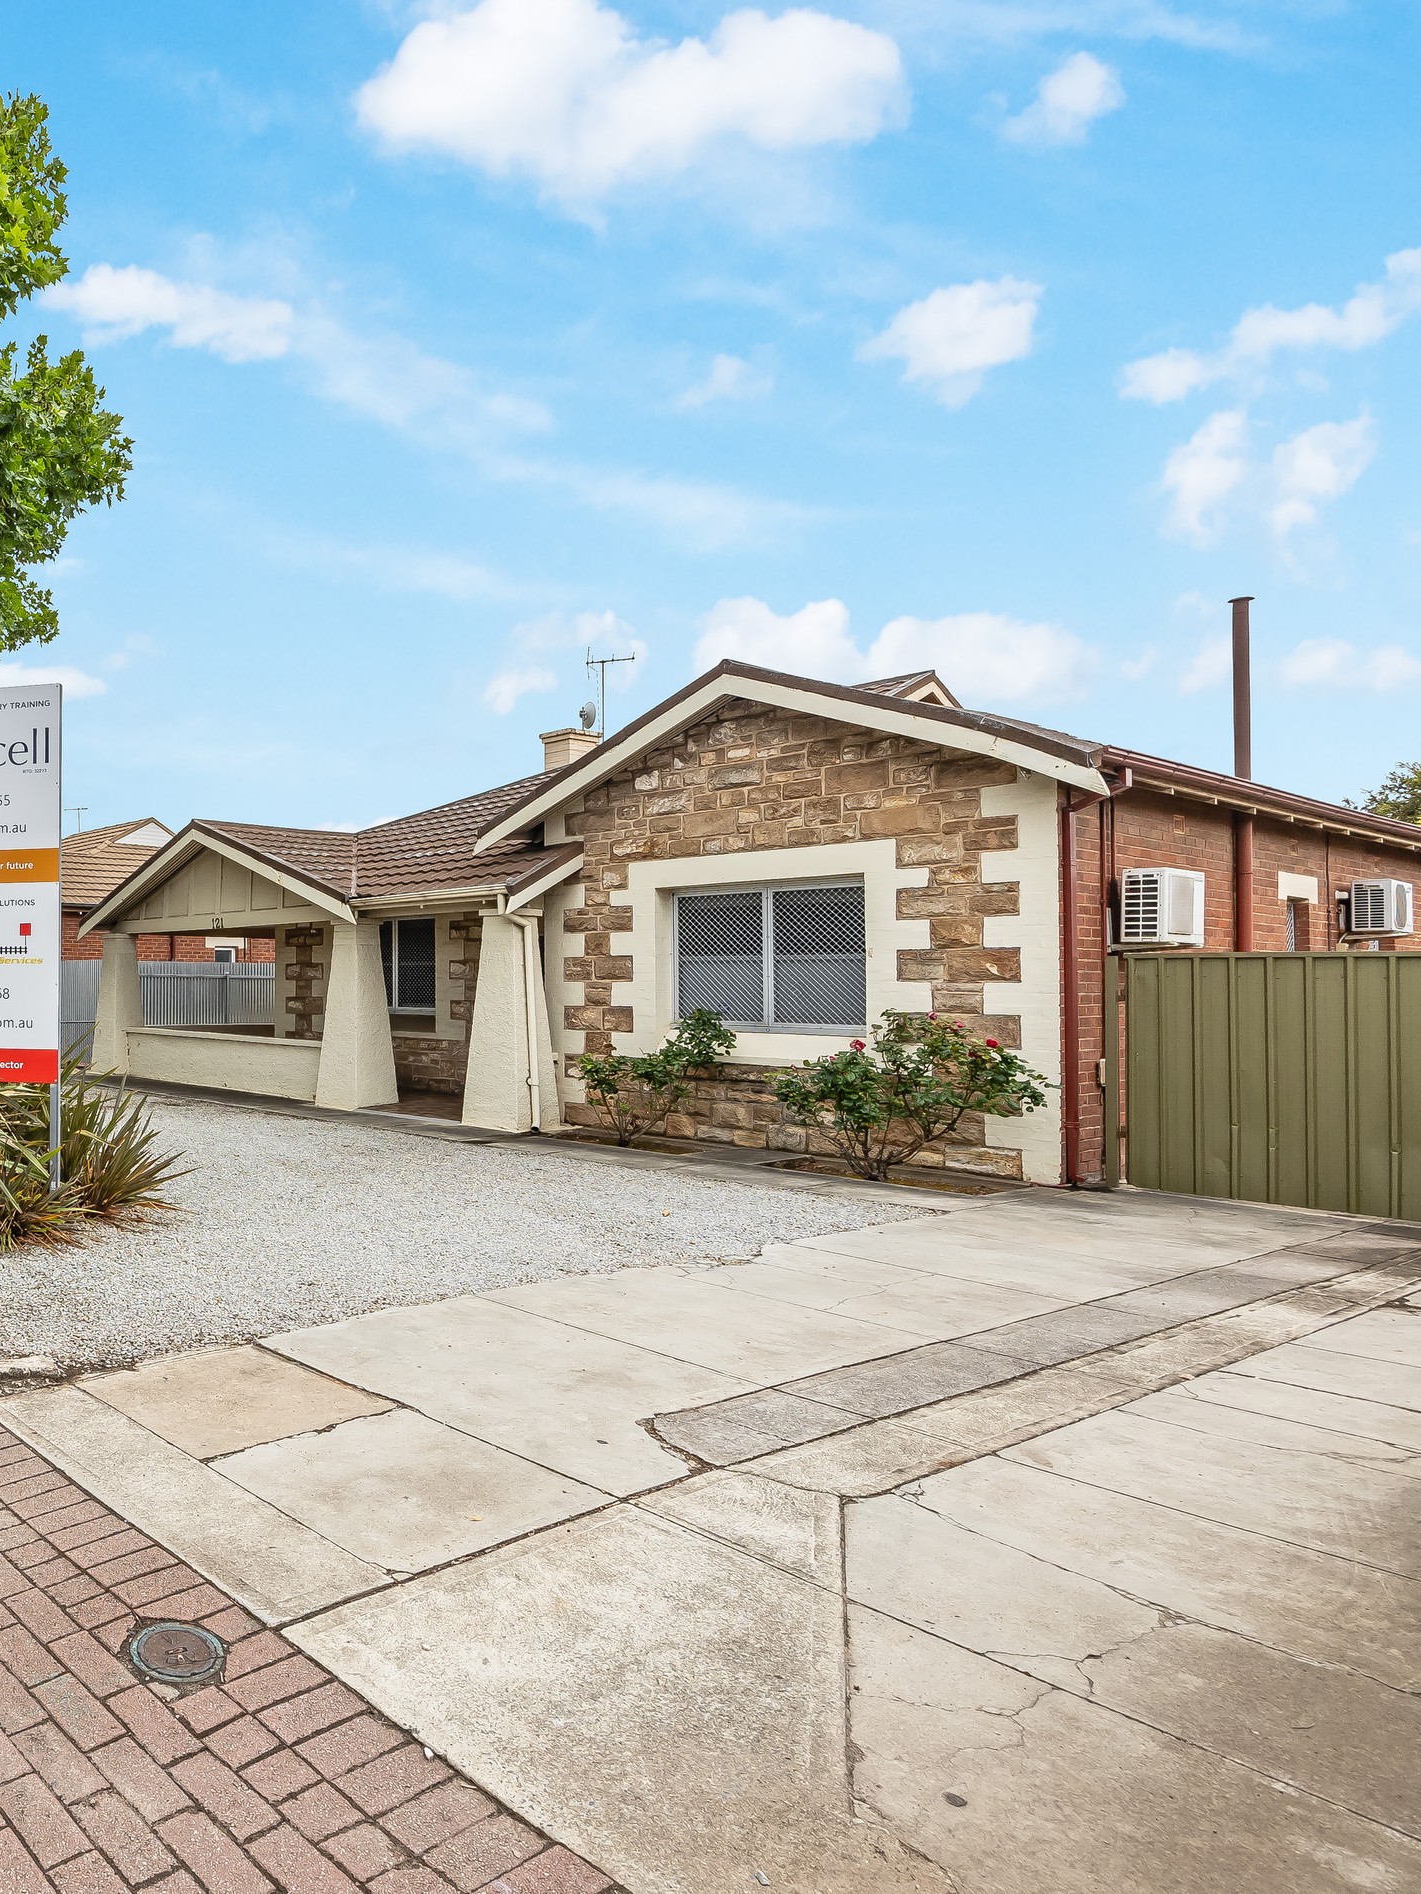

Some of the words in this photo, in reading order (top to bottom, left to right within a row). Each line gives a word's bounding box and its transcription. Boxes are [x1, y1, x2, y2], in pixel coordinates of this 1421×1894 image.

[10, 700, 51, 710] TRAINING
[6, 861, 34, 870] future
[212, 917, 224, 929] 121
